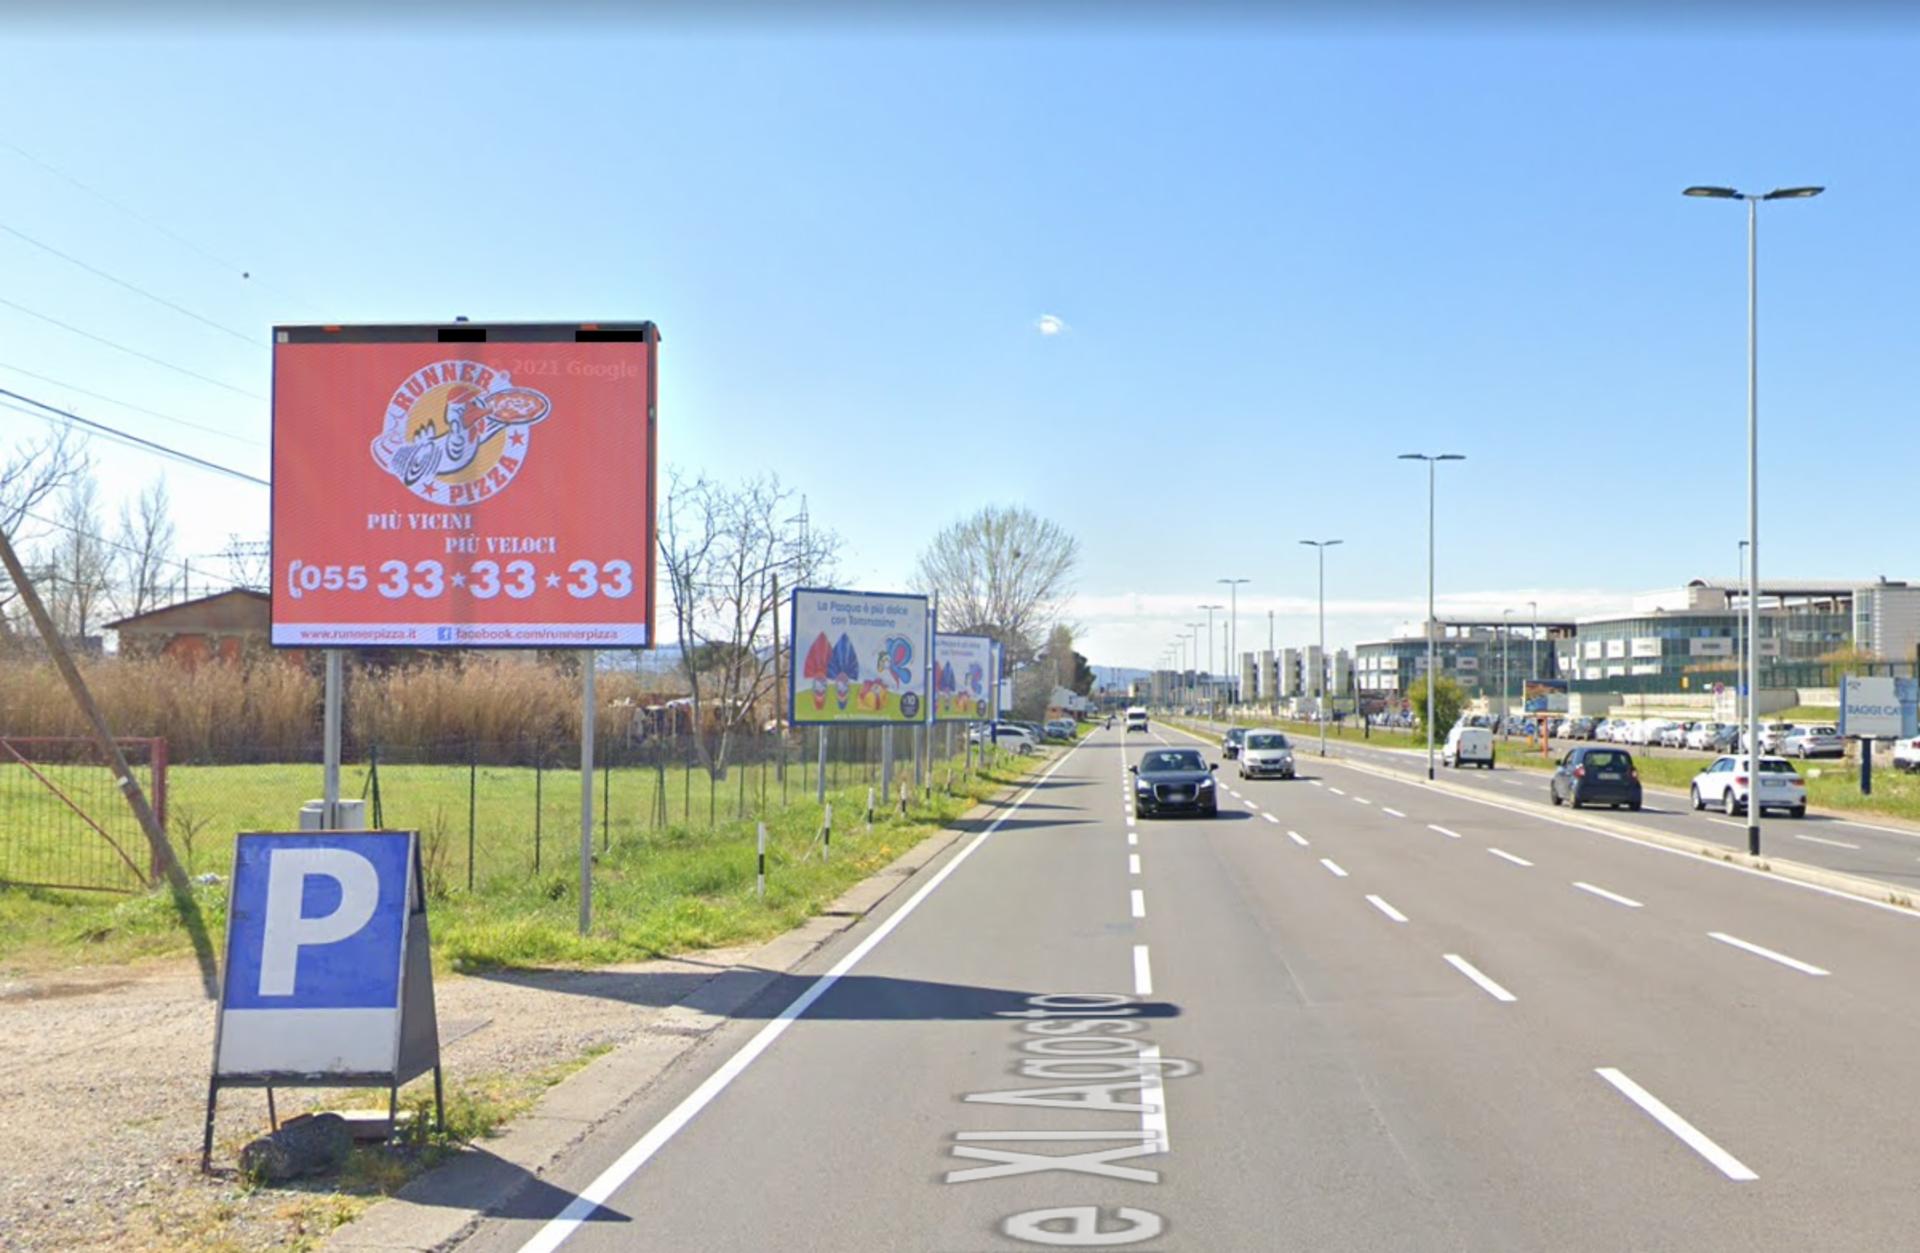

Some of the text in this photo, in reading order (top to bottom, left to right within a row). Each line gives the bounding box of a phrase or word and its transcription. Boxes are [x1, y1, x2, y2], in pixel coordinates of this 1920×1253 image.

[394, 362, 495, 412] RUNNER
[450, 456, 519, 503] PIZZA
[367, 510, 473, 530] PIÙ VICINI
[445, 534, 557, 554] PIÙ VELOCI
[299, 565, 369, 591] 055
[301, 628, 618, 640] www.runnerpizza.it facebook.com/runnerpizza
[258, 848, 380, 996] P
